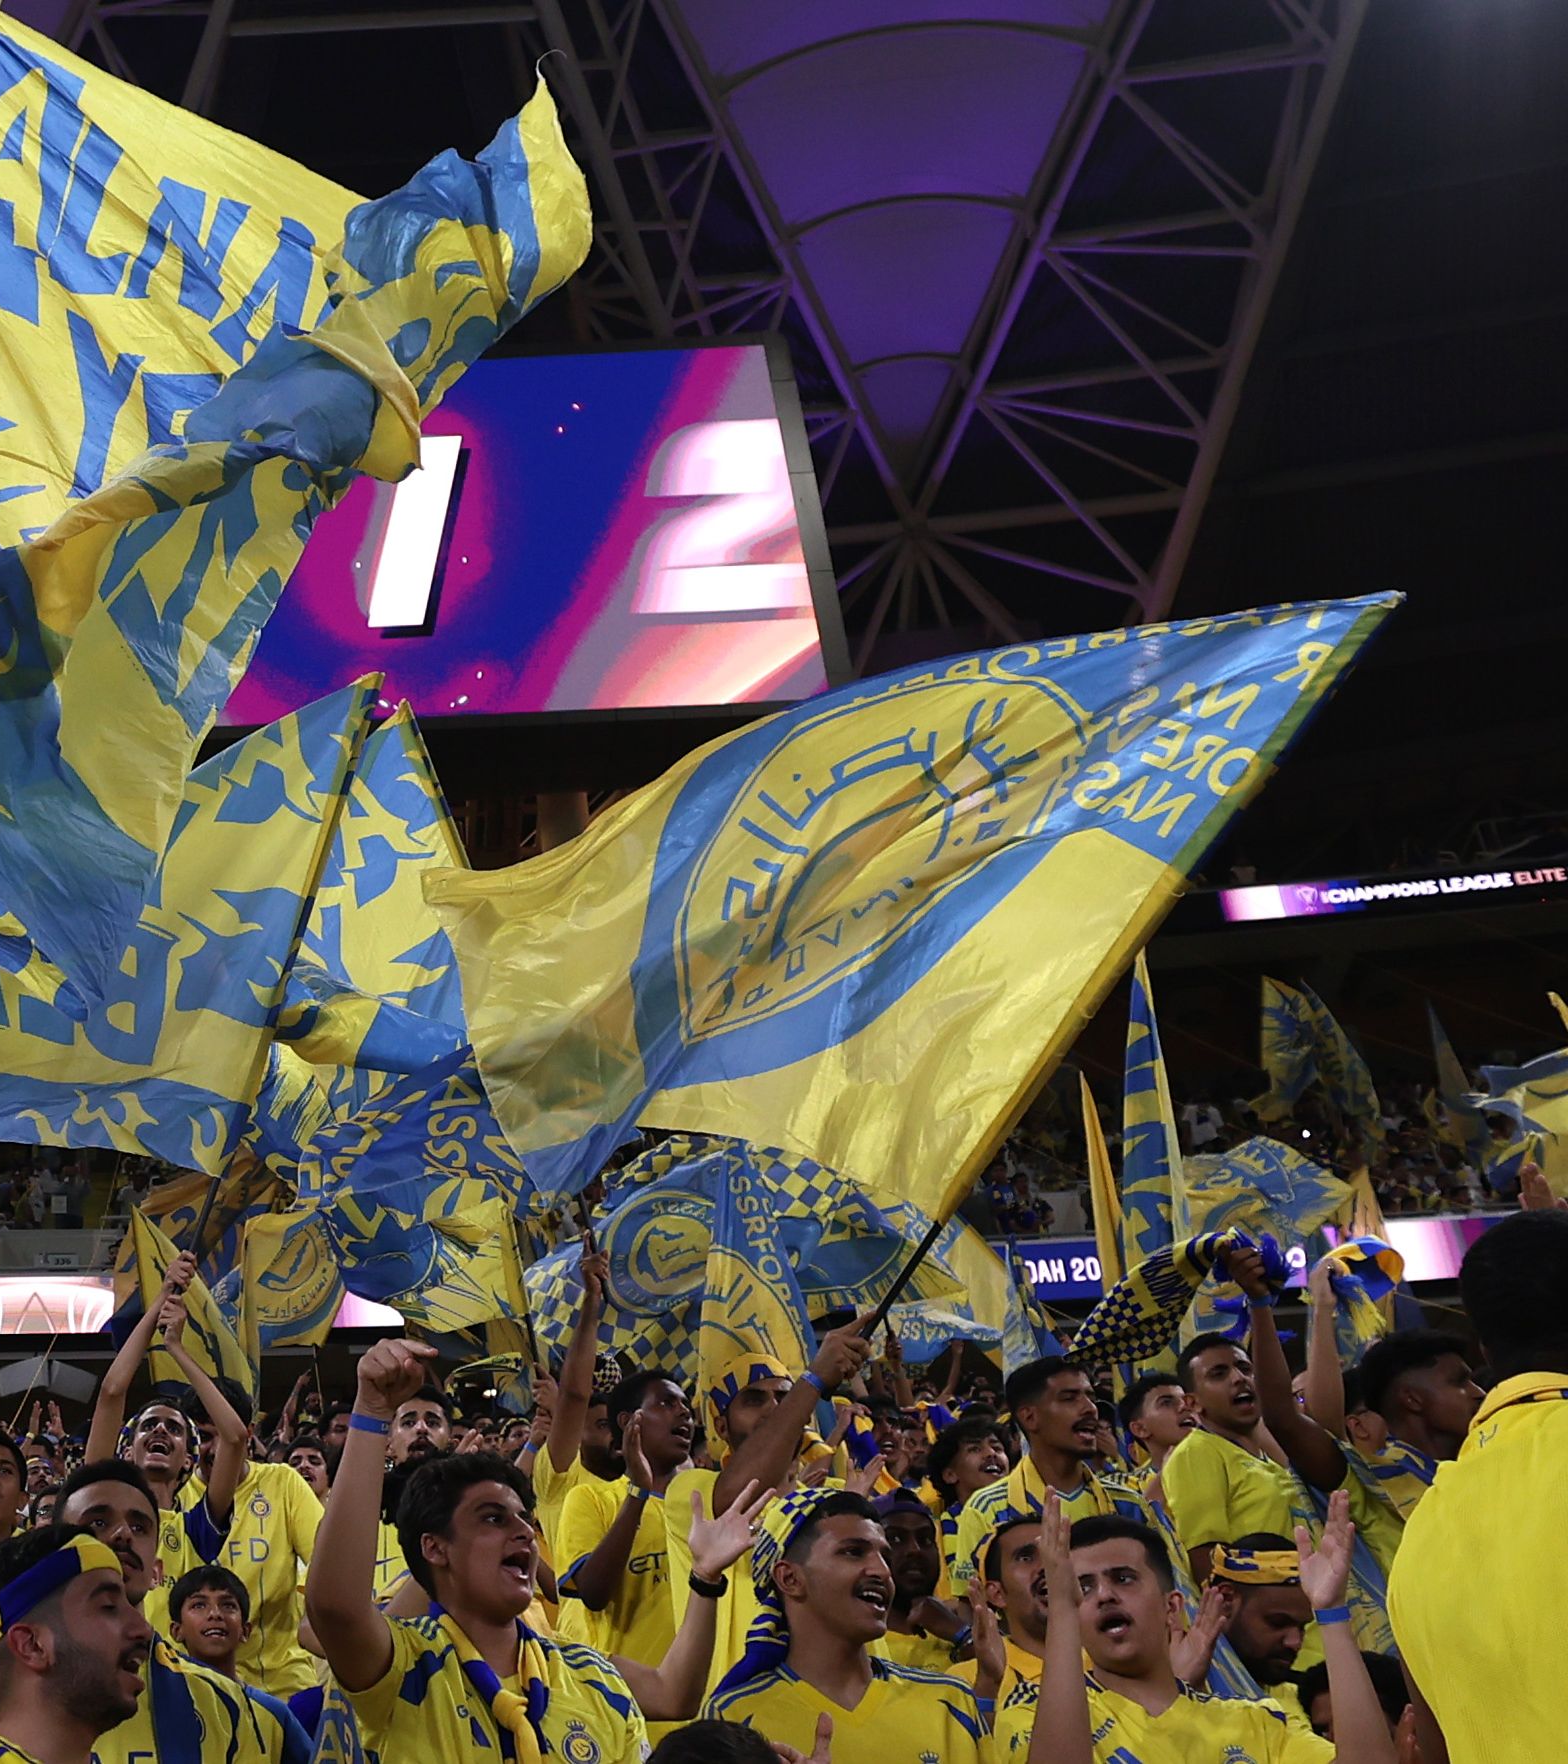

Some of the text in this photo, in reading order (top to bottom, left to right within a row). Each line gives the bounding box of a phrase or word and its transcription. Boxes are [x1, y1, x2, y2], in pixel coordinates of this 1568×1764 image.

[1328, 880, 1439, 904] CHAMPIONS
[1439, 872, 1515, 894] LEAGUE
[1514, 867, 1567, 886] ELITE
